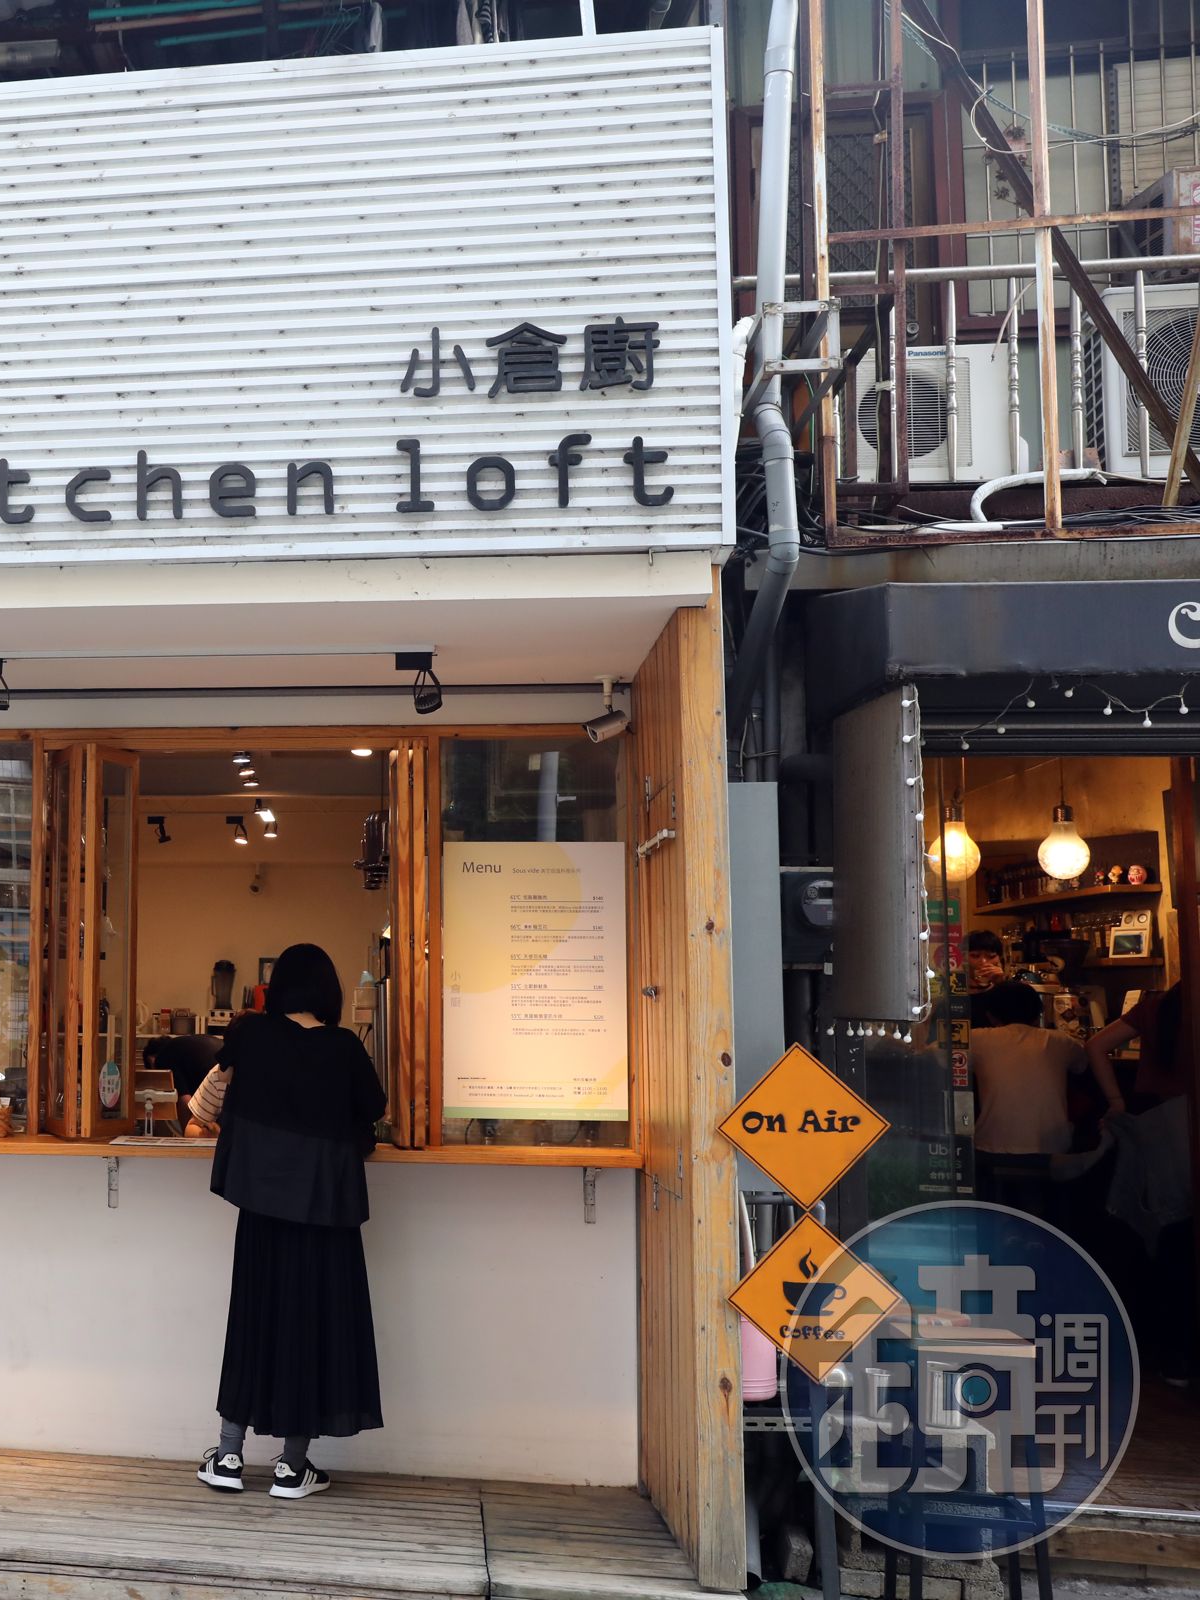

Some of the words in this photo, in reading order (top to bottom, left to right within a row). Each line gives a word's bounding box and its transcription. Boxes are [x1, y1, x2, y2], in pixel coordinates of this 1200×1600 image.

[401, 317, 661, 399] 小倉廚
[396, 433, 675, 515] loft
[462, 861, 502, 874] Menu
[741, 1110, 788, 1134] On
[797, 1109, 861, 1134] Air
[929, 1143, 962, 1156] Ubr
[929, 1157, 962, 1169] Eas
[778, 1324, 846, 1341] Coffee
